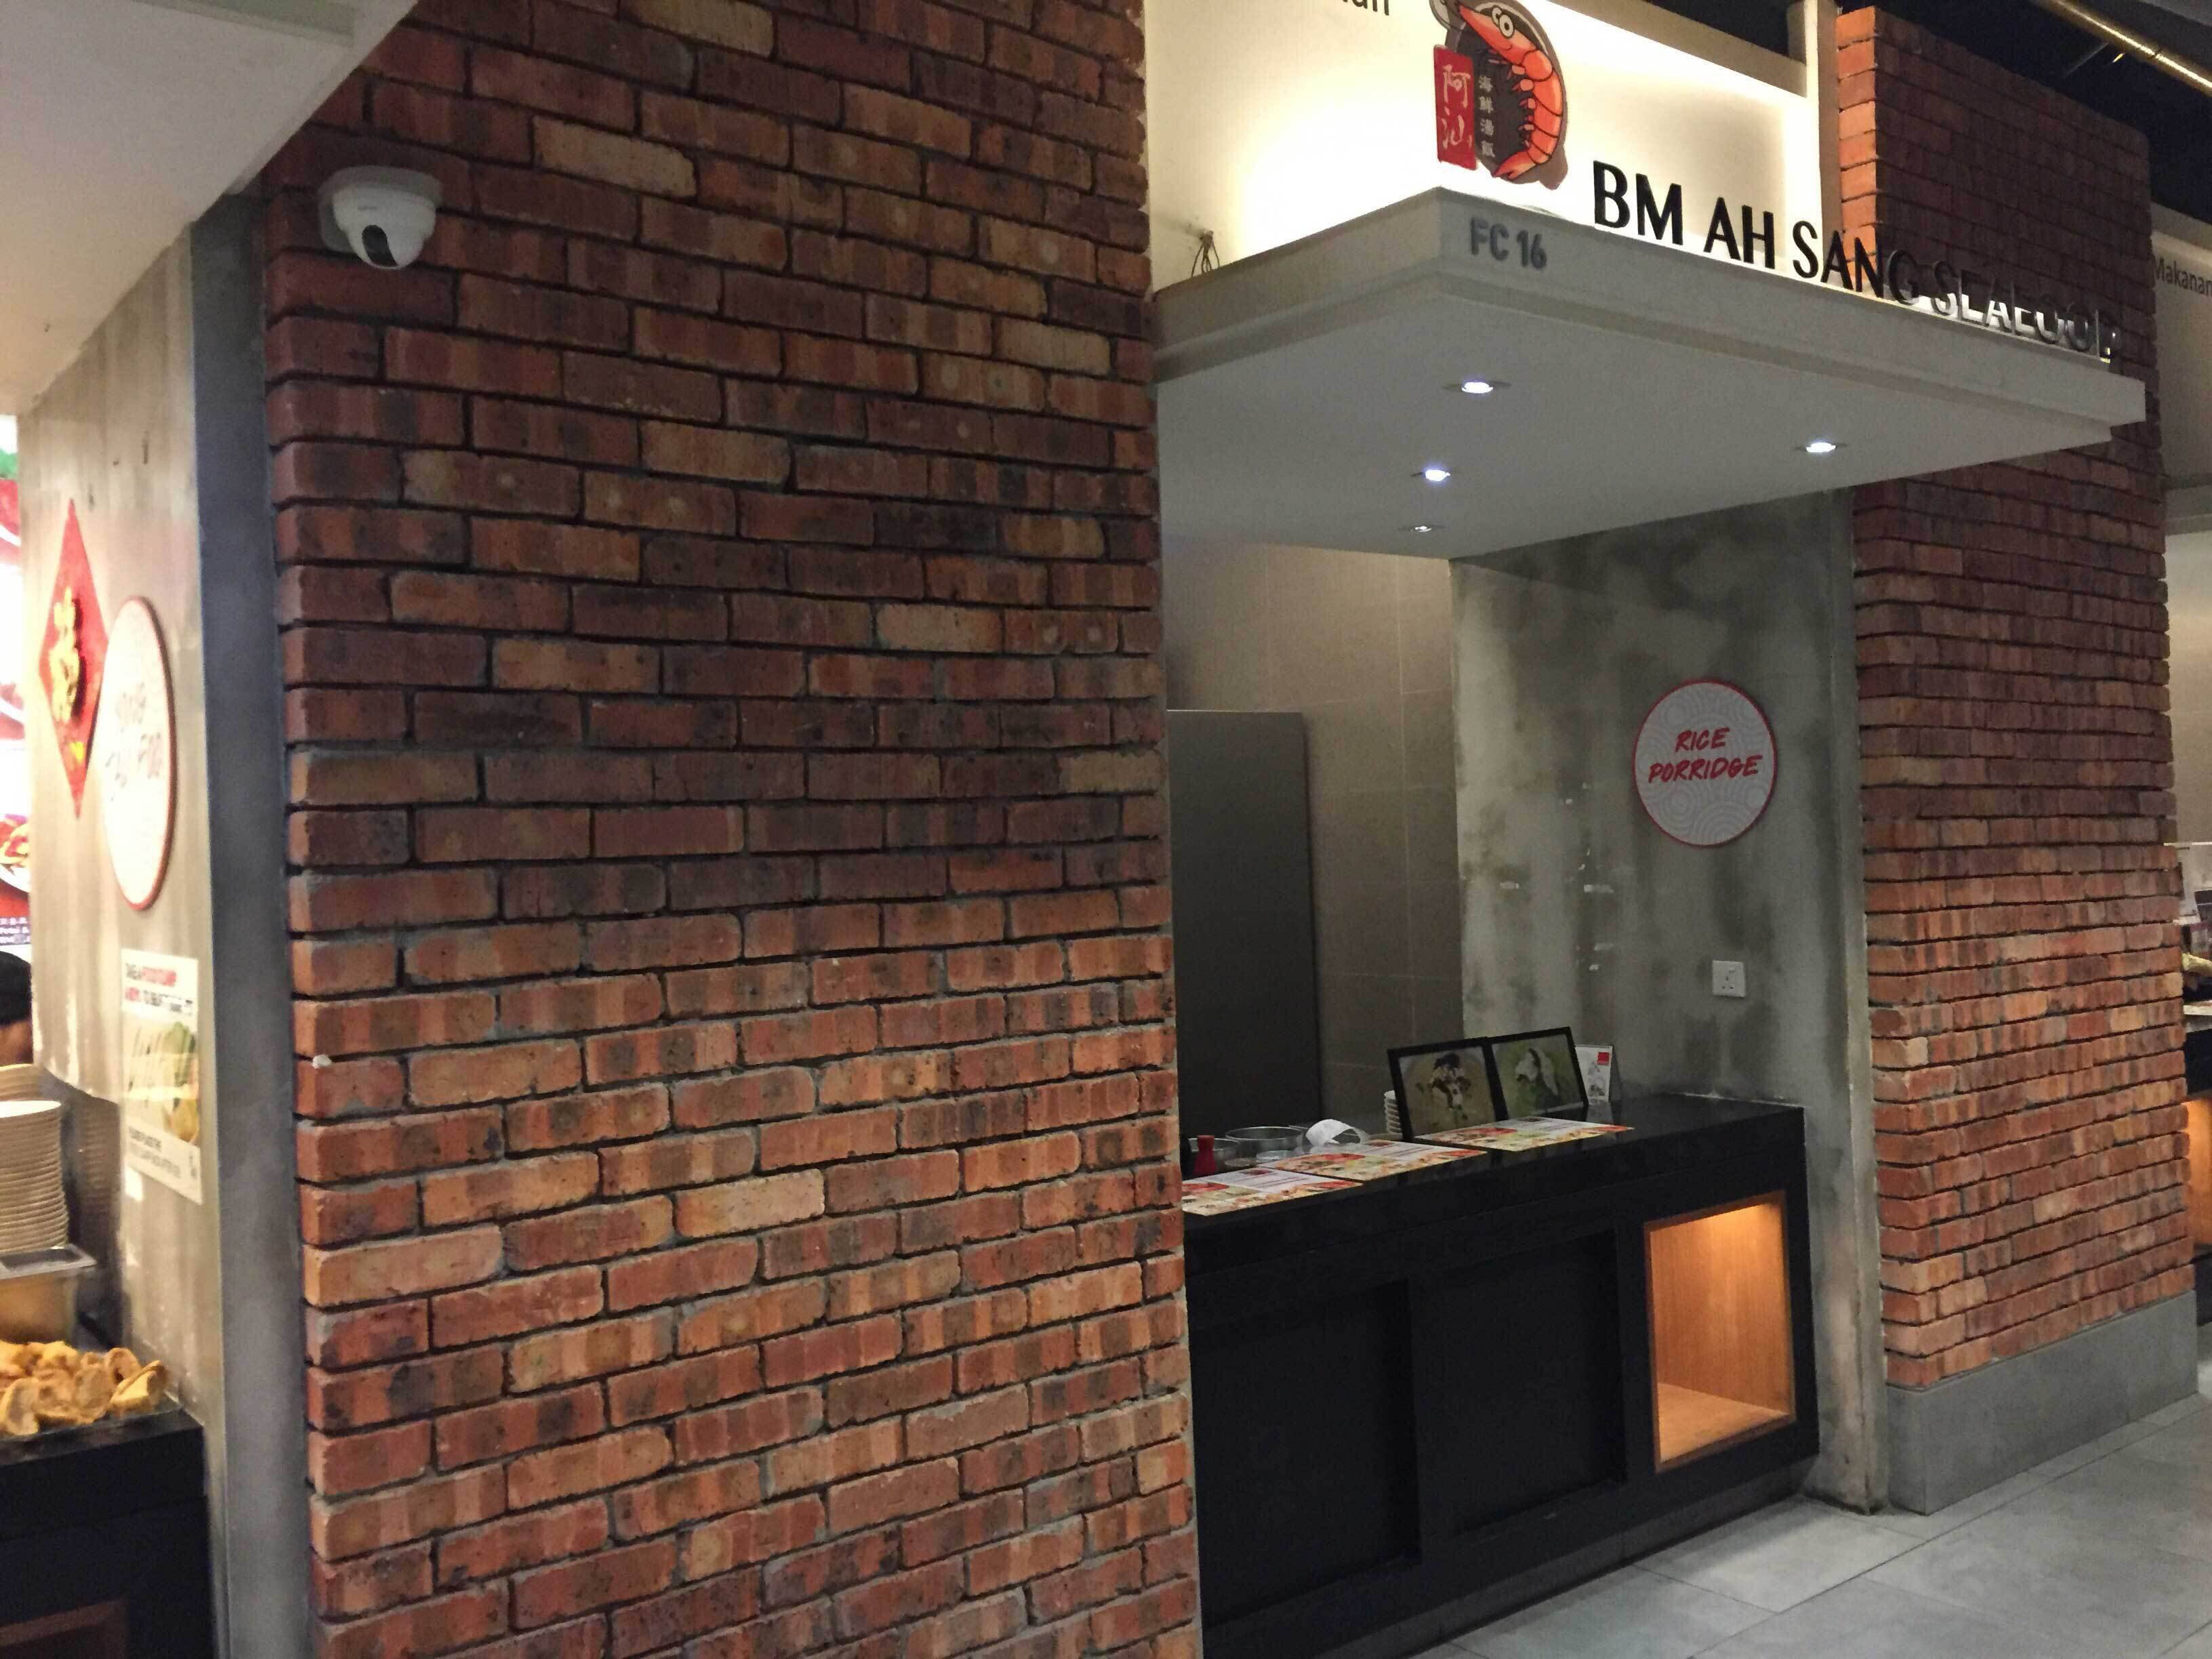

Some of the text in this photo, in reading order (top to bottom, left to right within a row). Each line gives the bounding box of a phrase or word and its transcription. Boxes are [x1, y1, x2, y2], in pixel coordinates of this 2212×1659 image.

[1469, 217, 1547, 270] FC 16
[1593, 160, 1683, 245] BM
[1703, 197, 1776, 270] AH
[1792, 220, 1921, 306] SANG
[1675, 727, 1730, 753] RICE
[1648, 755, 1763, 783] PORRIDGE
